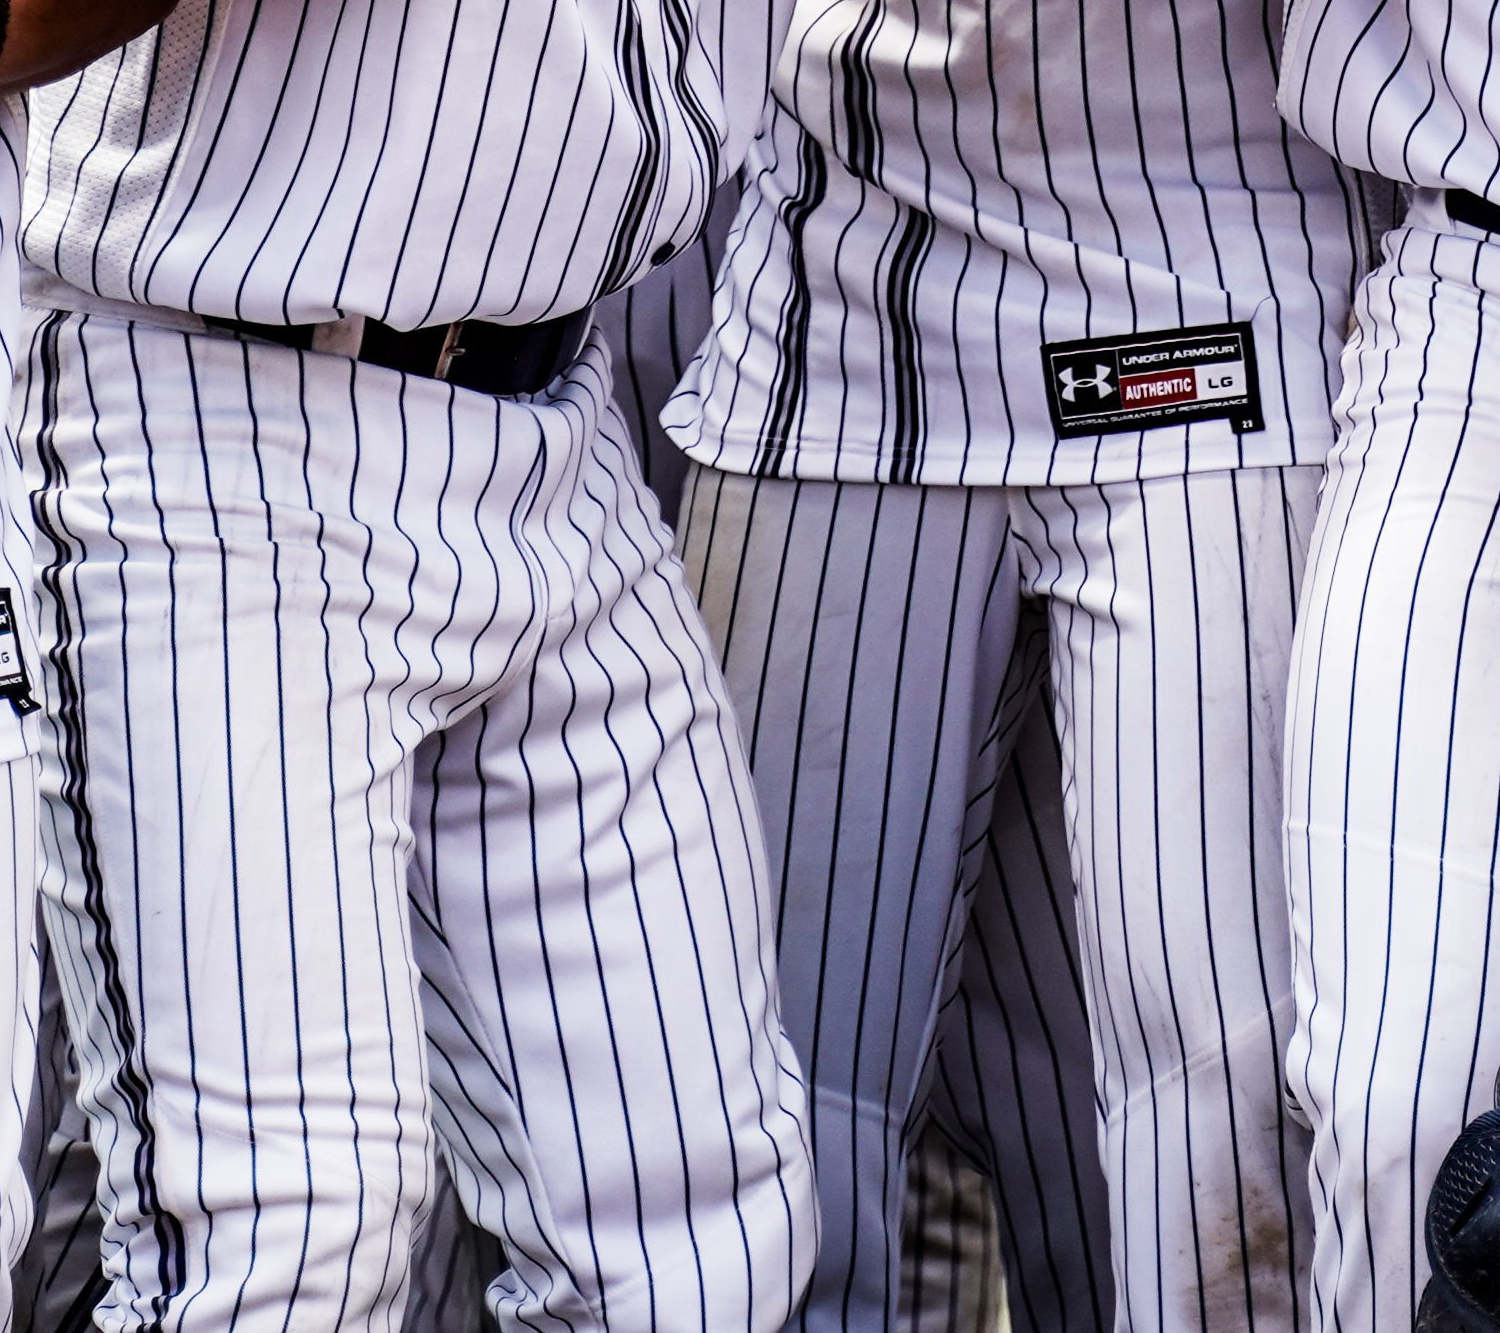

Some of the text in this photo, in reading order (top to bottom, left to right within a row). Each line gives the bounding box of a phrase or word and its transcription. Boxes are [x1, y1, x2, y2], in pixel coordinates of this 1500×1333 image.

[1121, 345, 1235, 366] UNDER ARMOUR
[1125, 376, 1233, 401] AUTHENTIC LG
[1062, 418, 1109, 428] UNIVERSAL
[1110, 410, 1162, 423] GUARANTEE
[1178, 398, 1248, 413] PERFORMANCE
